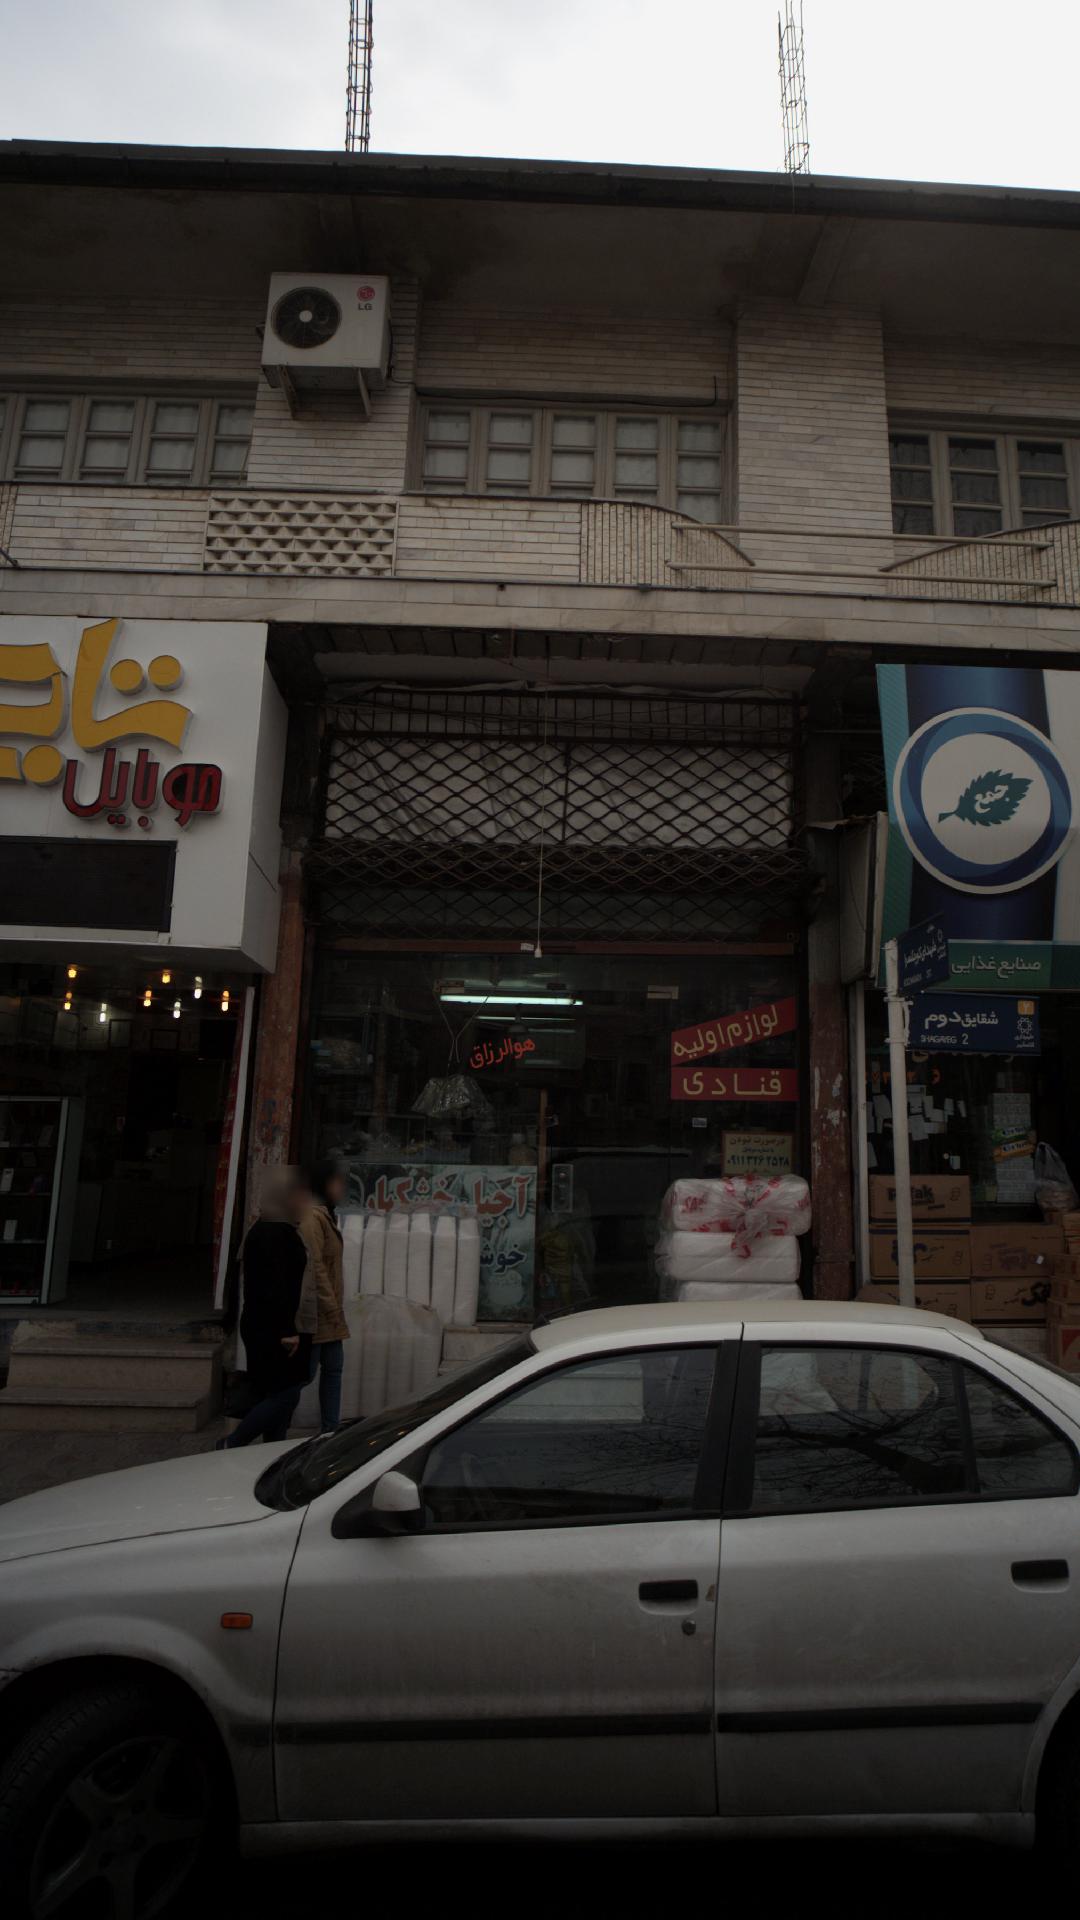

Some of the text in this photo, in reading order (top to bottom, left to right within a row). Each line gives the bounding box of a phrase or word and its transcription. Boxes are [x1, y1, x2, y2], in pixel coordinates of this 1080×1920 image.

[358, 302, 373, 311] LG
[62, 748, 222, 830] موبایل
[951, 954, 998, 974] غذایی
[997, 957, 1042, 978] صنایع
[924, 1011, 999, 1030] شقایق دوم
[673, 1004, 779, 1059] لوازم اولیه
[961, 1032, 969, 1045] 2
[469, 1037, 536, 1069] هوالرزاق
[682, 1070, 783, 1096] قنادی
